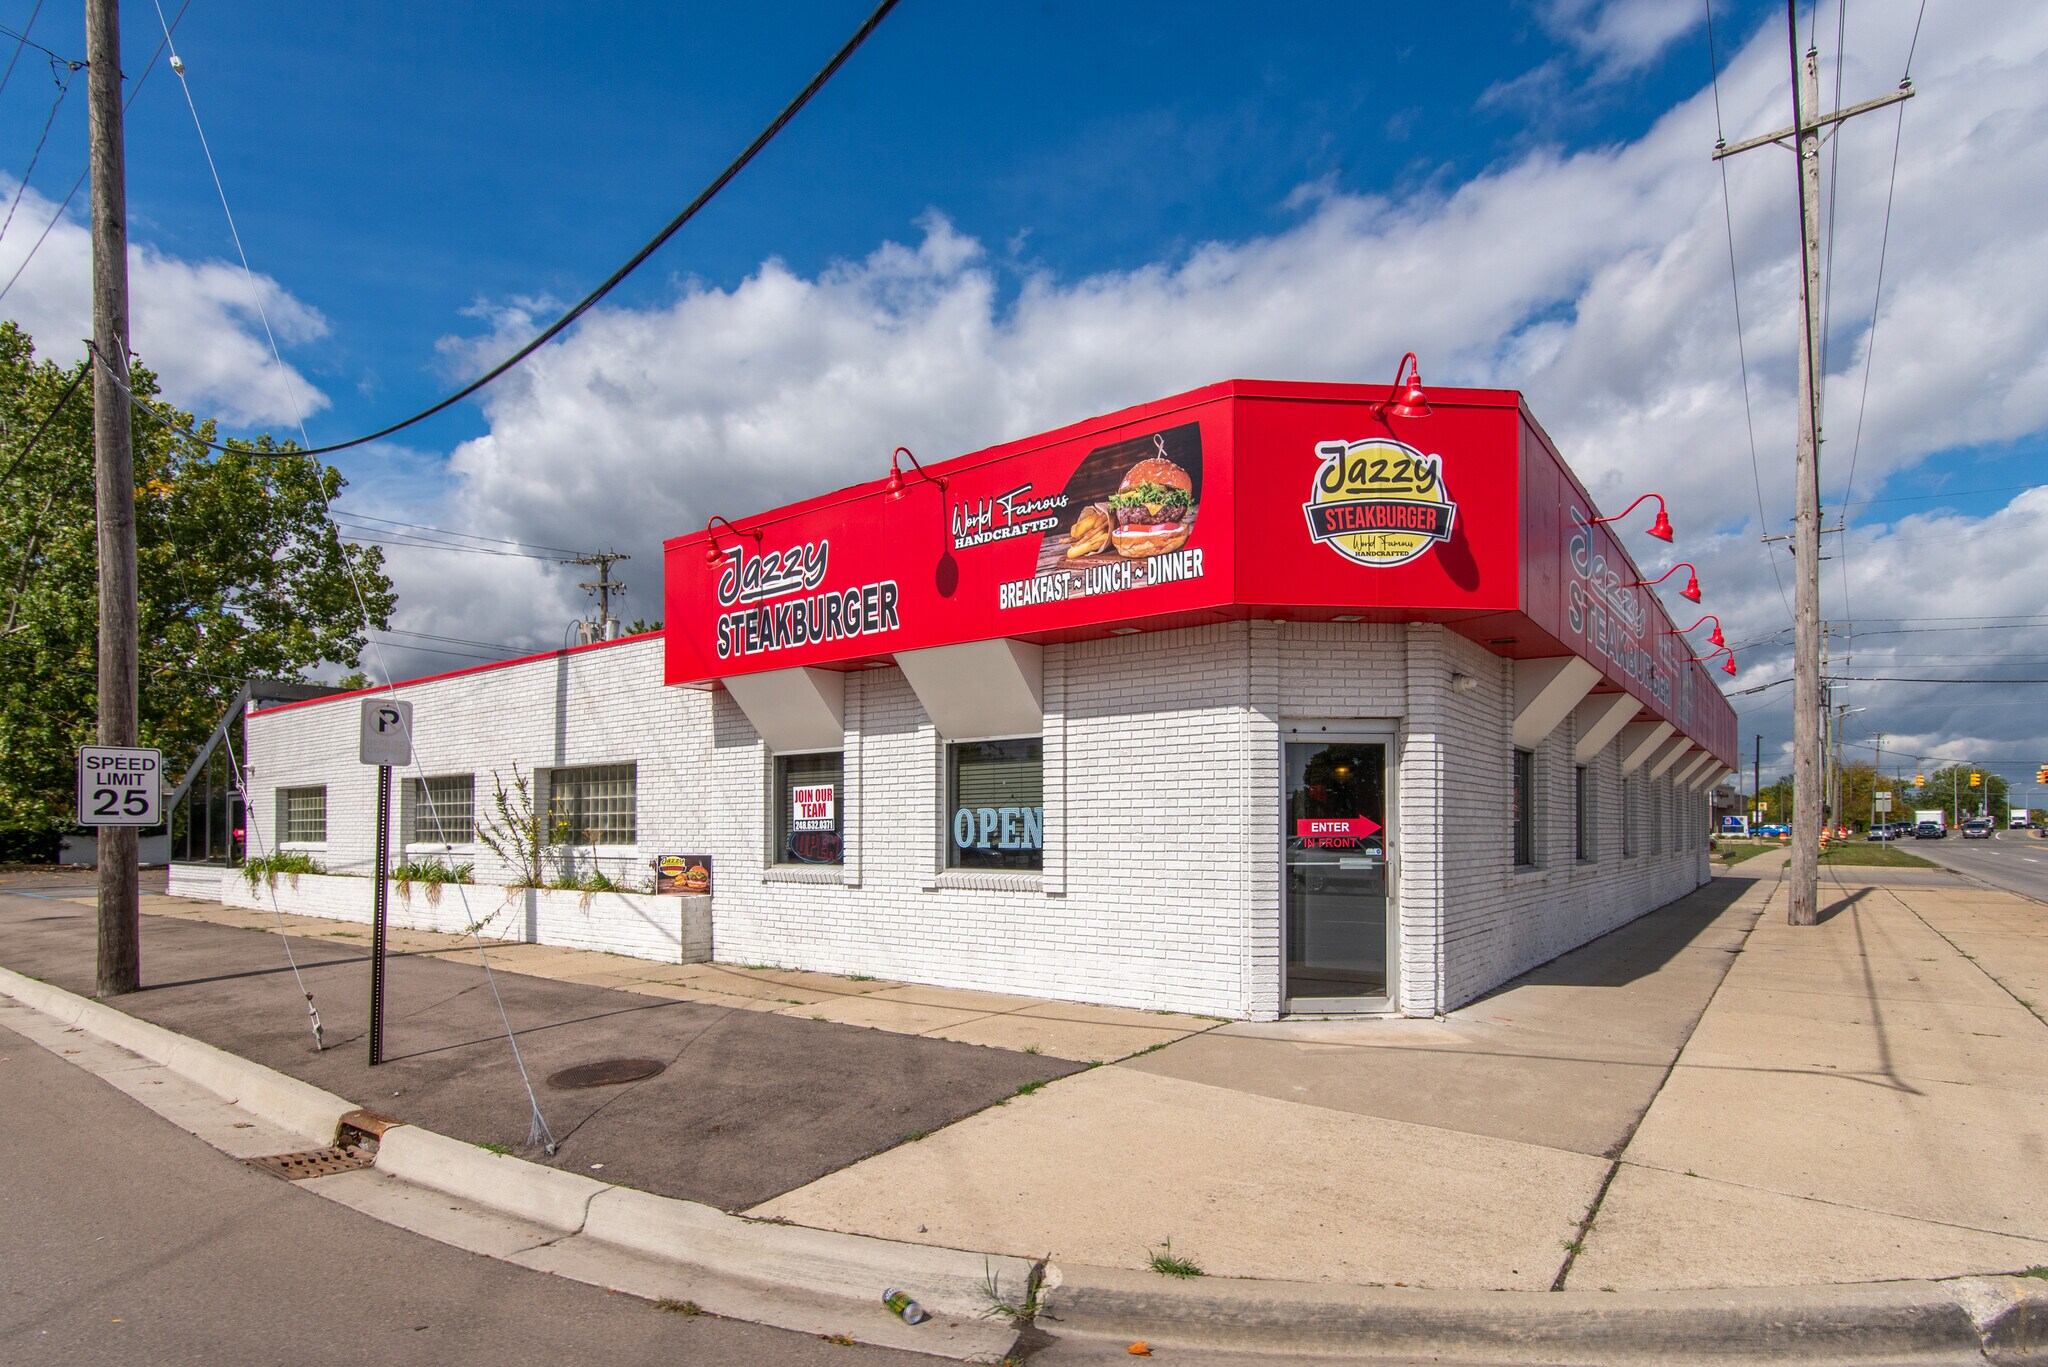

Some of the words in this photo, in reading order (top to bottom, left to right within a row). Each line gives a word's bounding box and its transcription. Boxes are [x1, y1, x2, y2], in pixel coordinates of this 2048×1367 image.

[1320, 445, 1438, 494] Jazzy
[953, 496, 993, 538] World
[996, 483, 1069, 527] Famous
[1324, 505, 1437, 532] STEAKBURGER
[954, 517, 1059, 550] HANDCRAFTED
[1353, 534, 1376, 552] World
[1378, 533, 1414, 550] Famous
[718, 539, 829, 607] Jazzy
[1000, 571, 1071, 610] BREAKFAST
[1085, 560, 1133, 596] LUNCH
[1146, 548, 1204, 587] DINNER
[1570, 505, 1646, 640] Jazzy
[717, 580, 899, 659] STEAKBURGER
[1569, 579, 1672, 710] STEAKBURGER
[86, 756, 156, 770] SPEED
[96, 772, 145, 786] LIMIT
[93, 789, 149, 816] 25
[795, 789, 813, 803] JOIN
[815, 788, 833, 802] OUR
[801, 803, 827, 818] TEAM
[954, 807, 1043, 849] OPEN
[1303, 837, 1315, 847] IN
[1318, 837, 1357, 847] FRONT
[1311, 822, 1350, 832] ENTER
